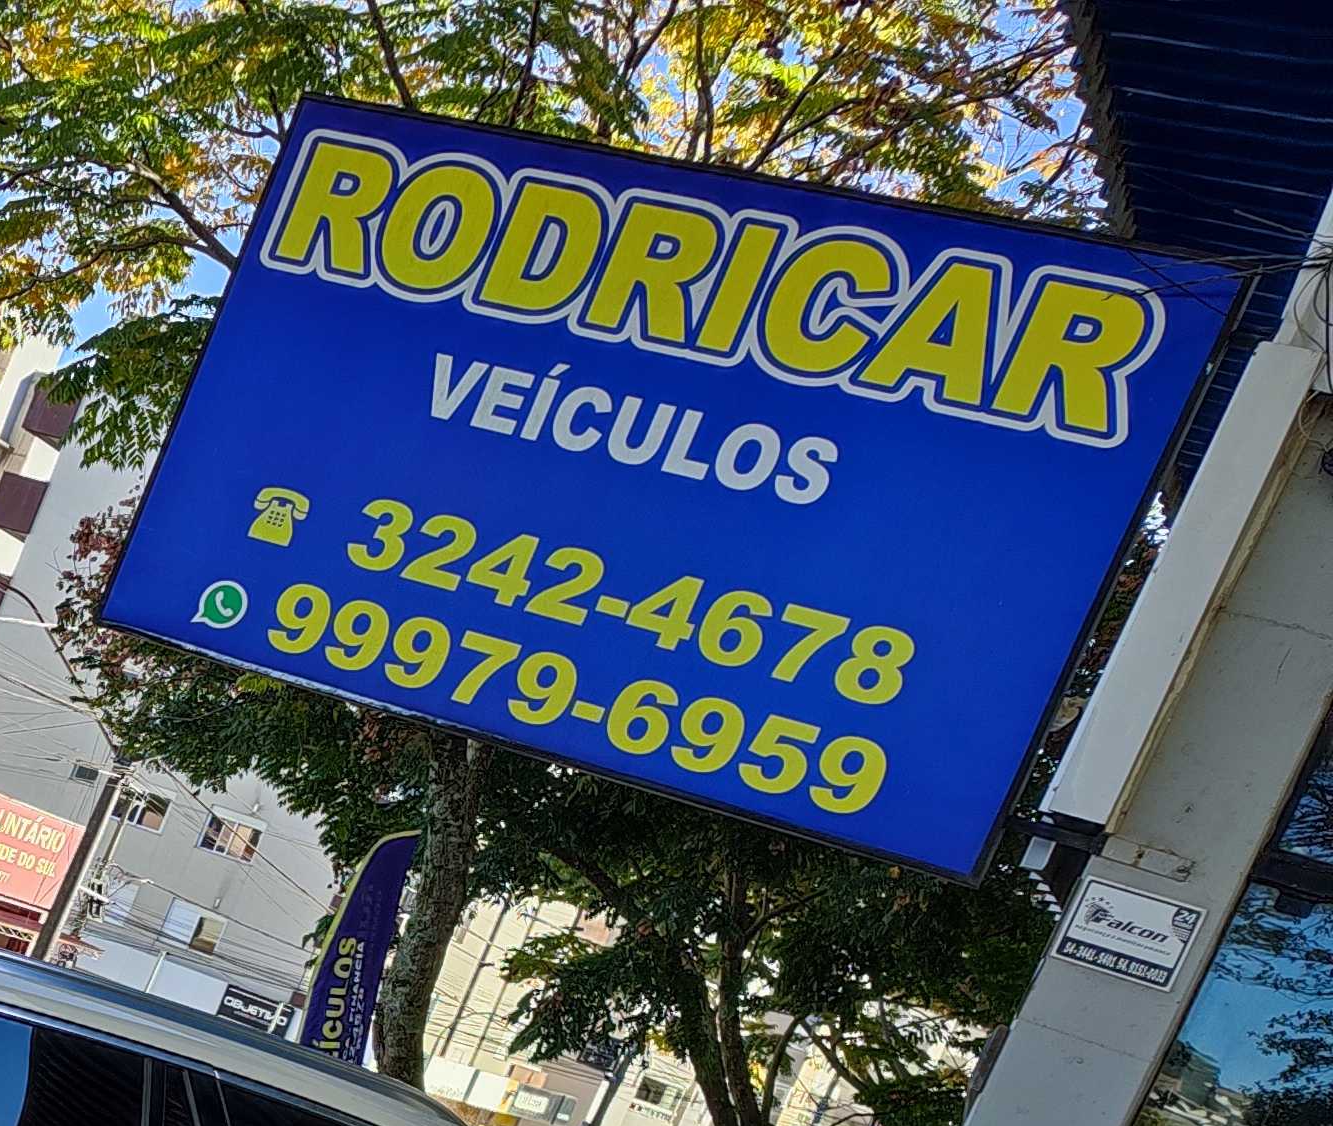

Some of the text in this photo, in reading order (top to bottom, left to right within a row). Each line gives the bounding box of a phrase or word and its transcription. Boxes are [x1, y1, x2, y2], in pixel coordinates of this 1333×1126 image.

[263, 130, 1163, 446] RODRICAR
[429, 351, 841, 505] VEÍCULOS
[346, 497, 917, 709] 3242-4678
[266, 583, 889, 814] 99979-6959
[18, 852, 36, 871] DO
[36, 857, 56, 878] SUL
[1089, 906, 1170, 943] Falcon
[313, 936, 357, 1057] ÍCULOS
